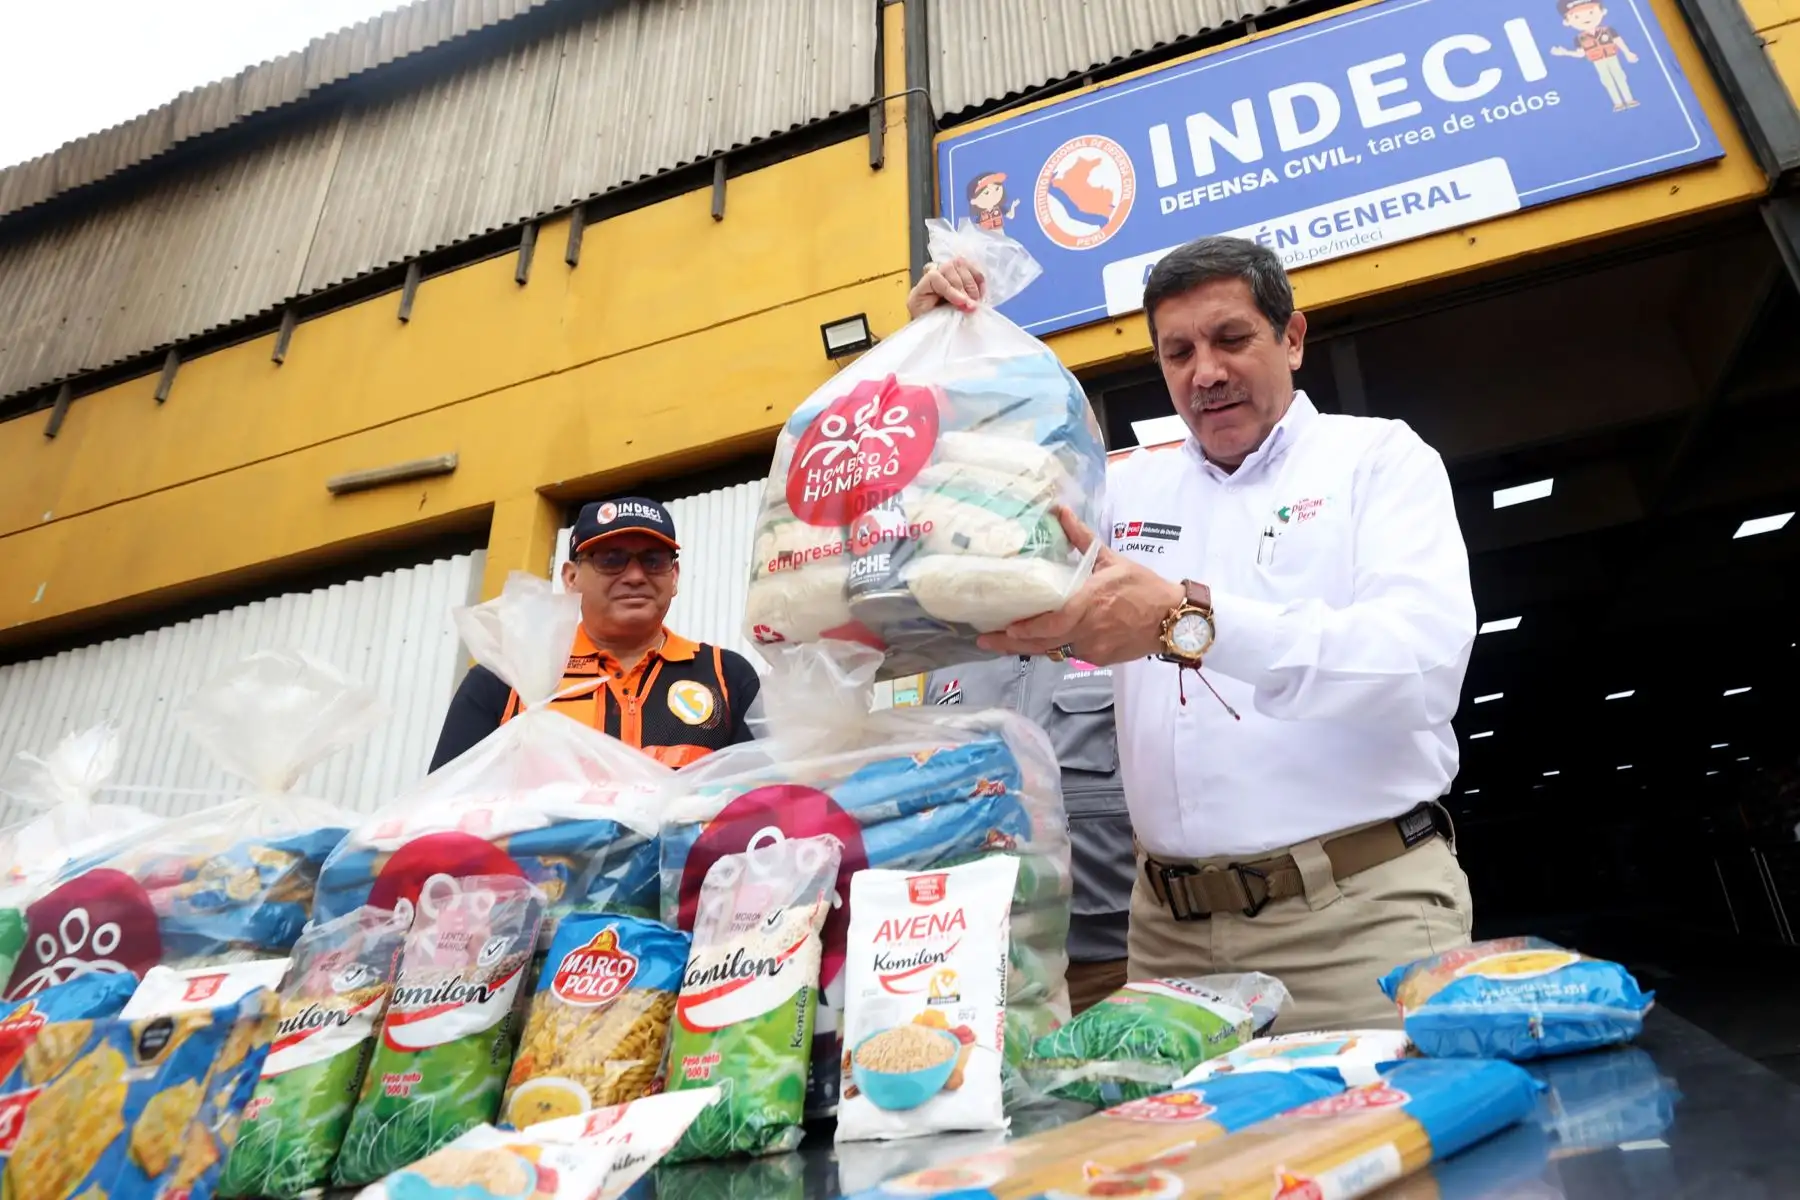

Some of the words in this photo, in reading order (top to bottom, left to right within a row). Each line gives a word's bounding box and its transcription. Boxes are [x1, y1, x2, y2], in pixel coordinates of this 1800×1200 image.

[1148, 17, 1548, 189] INDECI
[1160, 171, 1280, 216] DEFENSA
[1284, 146, 1362, 181] CIVIL,
[1367, 126, 1436, 156] tarea
[1443, 109, 1476, 135] de
[1480, 90, 1561, 125] todos
[1307, 180, 1472, 238] GENERAL
[1281, 229, 1383, 263] ob.pe/indeci
[803, 458, 900, 502] HOMBRO
[807, 451, 881, 484] HOMBRO
[618, 502, 661, 520] INDECI
[767, 537, 854, 573] empresas
[859, 520, 933, 548] contigo
[1126, 543, 1155, 553] CHAVEZ
[849, 553, 891, 579] ECHE
[873, 908, 966, 944] AVENA
[560, 954, 633, 978] MARCO
[873, 947, 947, 972] Komilon
[392, 971, 495, 1005] omilon
[560, 974, 620, 997] POLO
[790, 984, 809, 1048] Komilon
